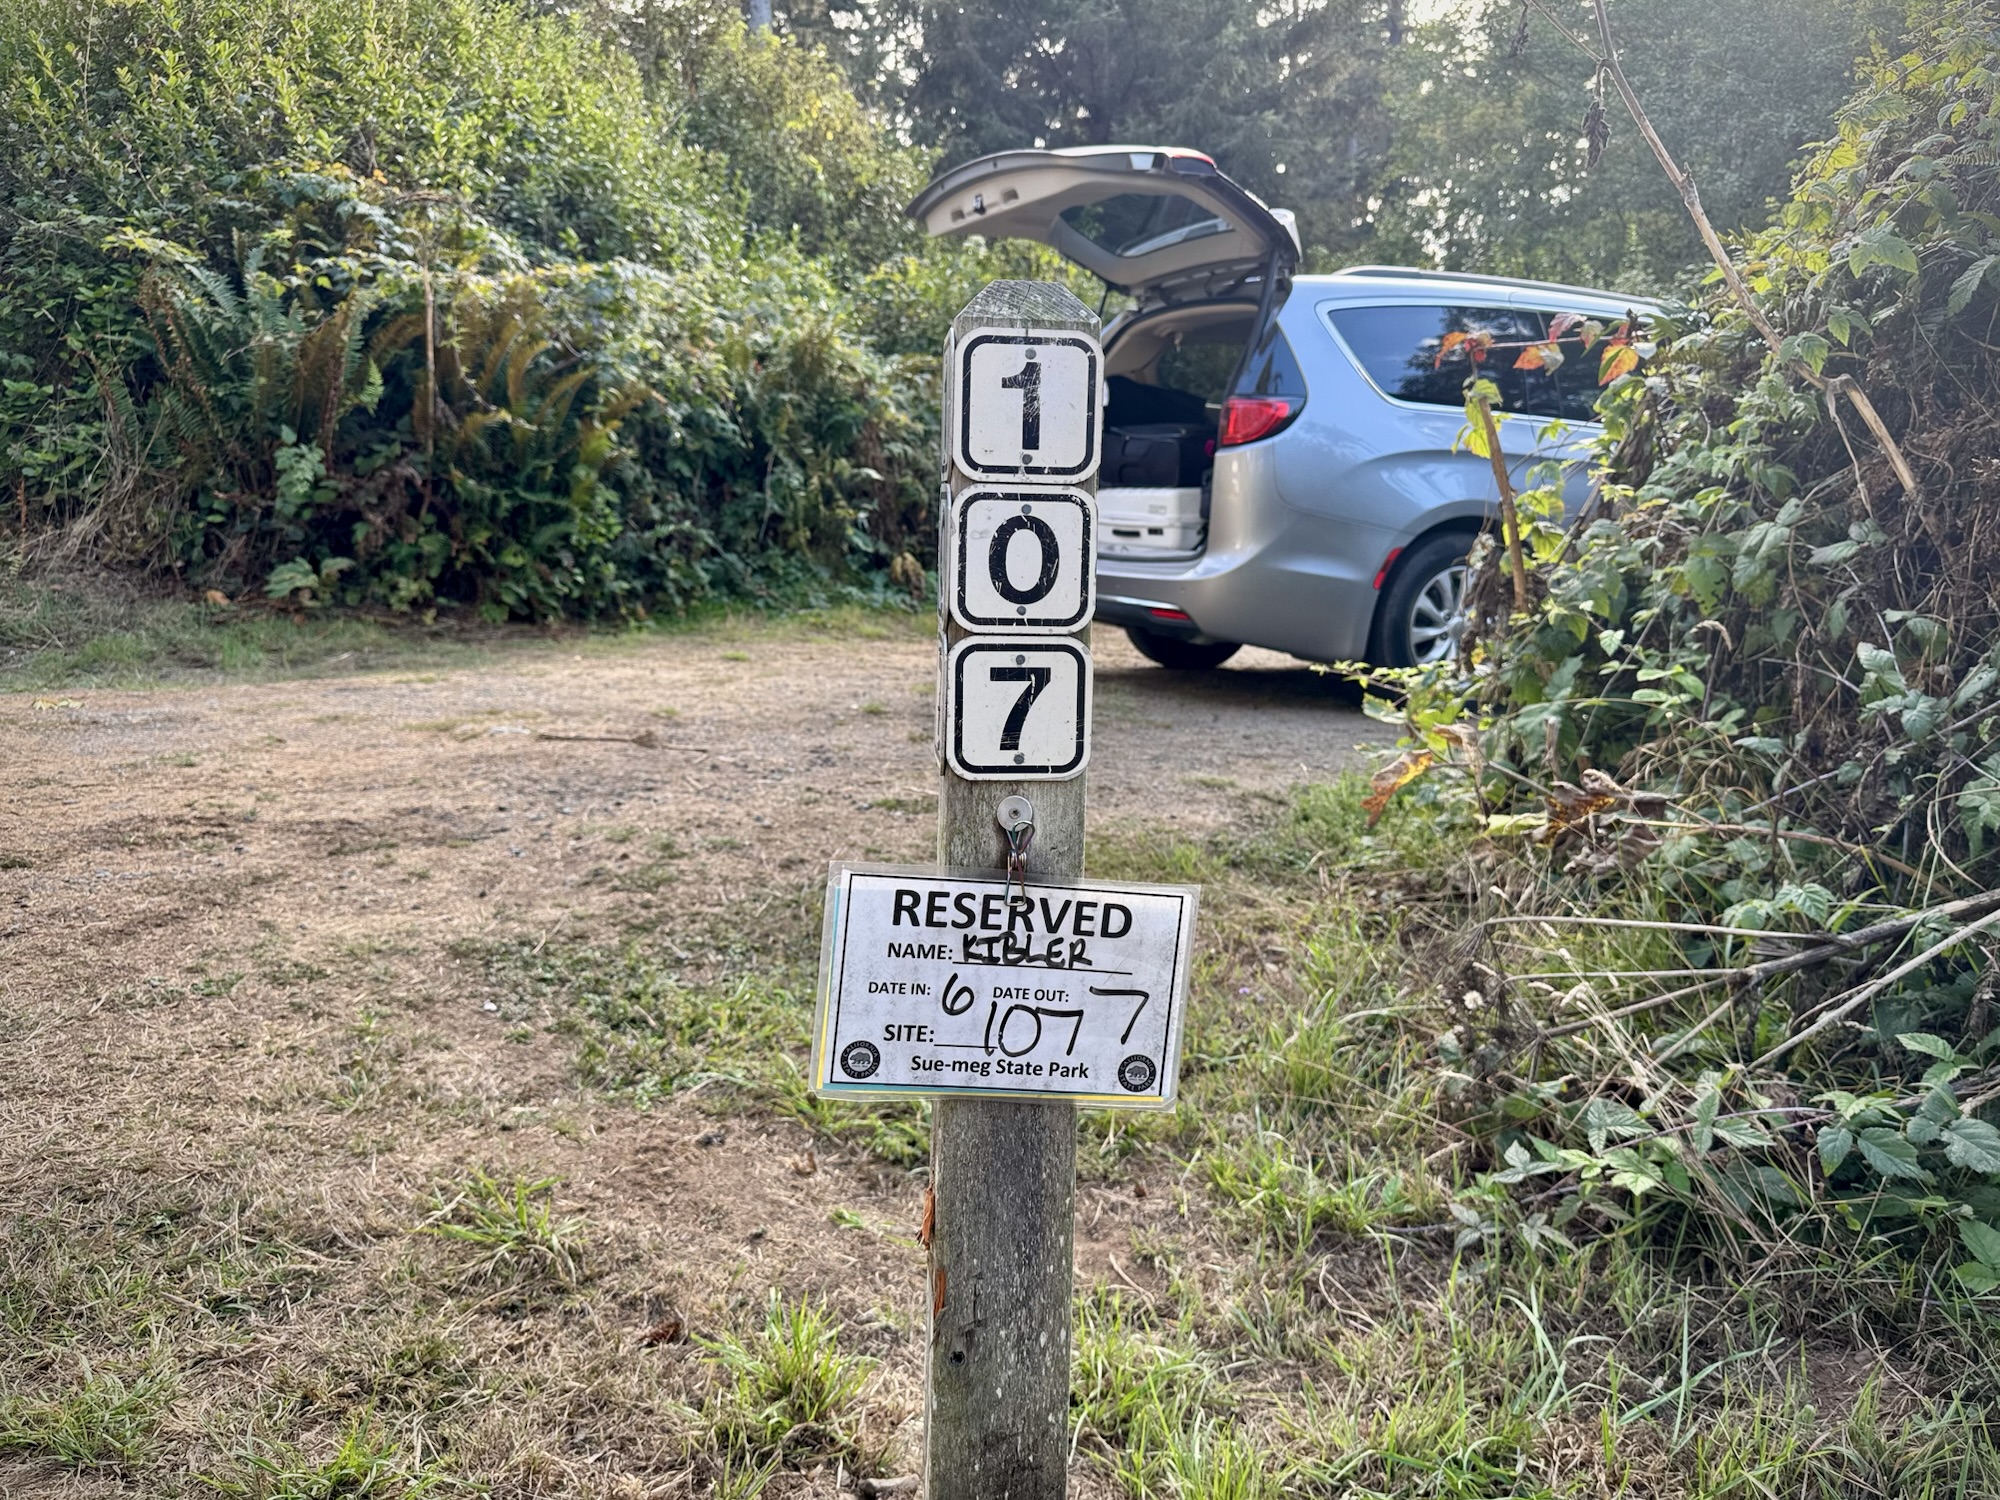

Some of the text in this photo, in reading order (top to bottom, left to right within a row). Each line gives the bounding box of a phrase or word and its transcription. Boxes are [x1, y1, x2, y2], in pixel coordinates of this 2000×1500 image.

[1001, 361, 1042, 450] 1
[989, 515, 1060, 604] 0
[990, 667, 1052, 751] 7
[892, 889, 1133, 938] RESERVED
[887, 931, 1092, 968] NAME: KIBLER
[868, 973, 1150, 1045] DATE IN: 6 DATE OUT: 7
[883, 1001, 1084, 1057] SITE: 107
[911, 1055, 1089, 1079] Sue-meg State Park
